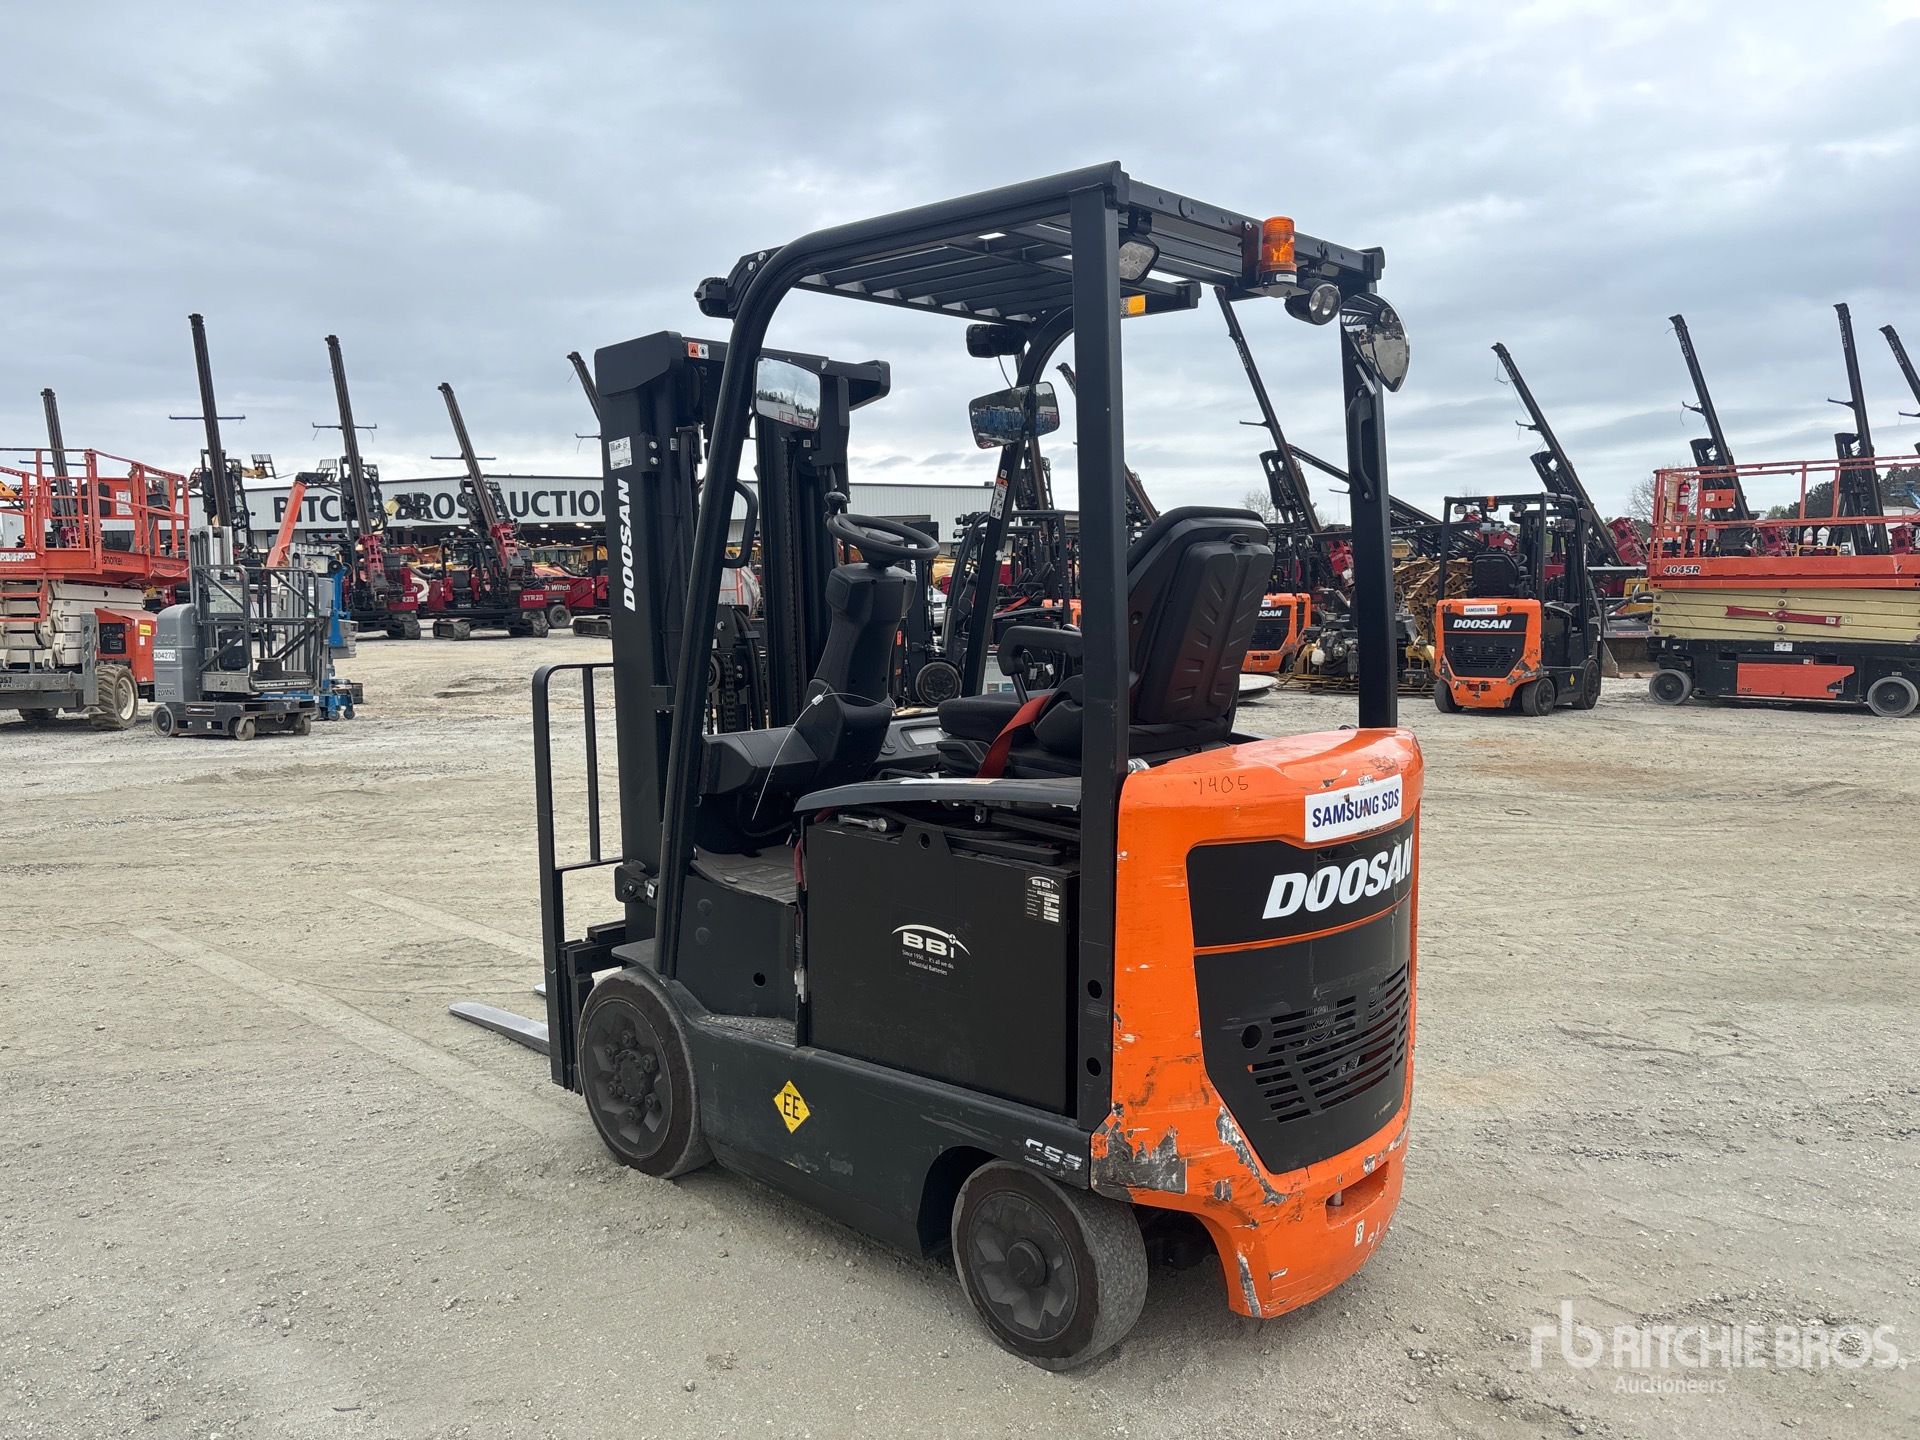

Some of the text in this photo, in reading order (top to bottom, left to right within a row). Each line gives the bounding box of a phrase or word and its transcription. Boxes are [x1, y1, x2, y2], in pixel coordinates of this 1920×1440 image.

[617, 478, 636, 612] DOOSAN
[1663, 565, 1701, 574] 4045R
[1453, 619, 1512, 629] DOOSAN
[154, 652, 175, 660] 304270
[1312, 788, 1400, 828] SAMSUNG SDS
[1262, 833, 1414, 920] DOOSAN
[901, 949, 913, 958] Since
[908, 959, 947, 976] Industrial Batteries
[783, 1092, 801, 1121] EE
